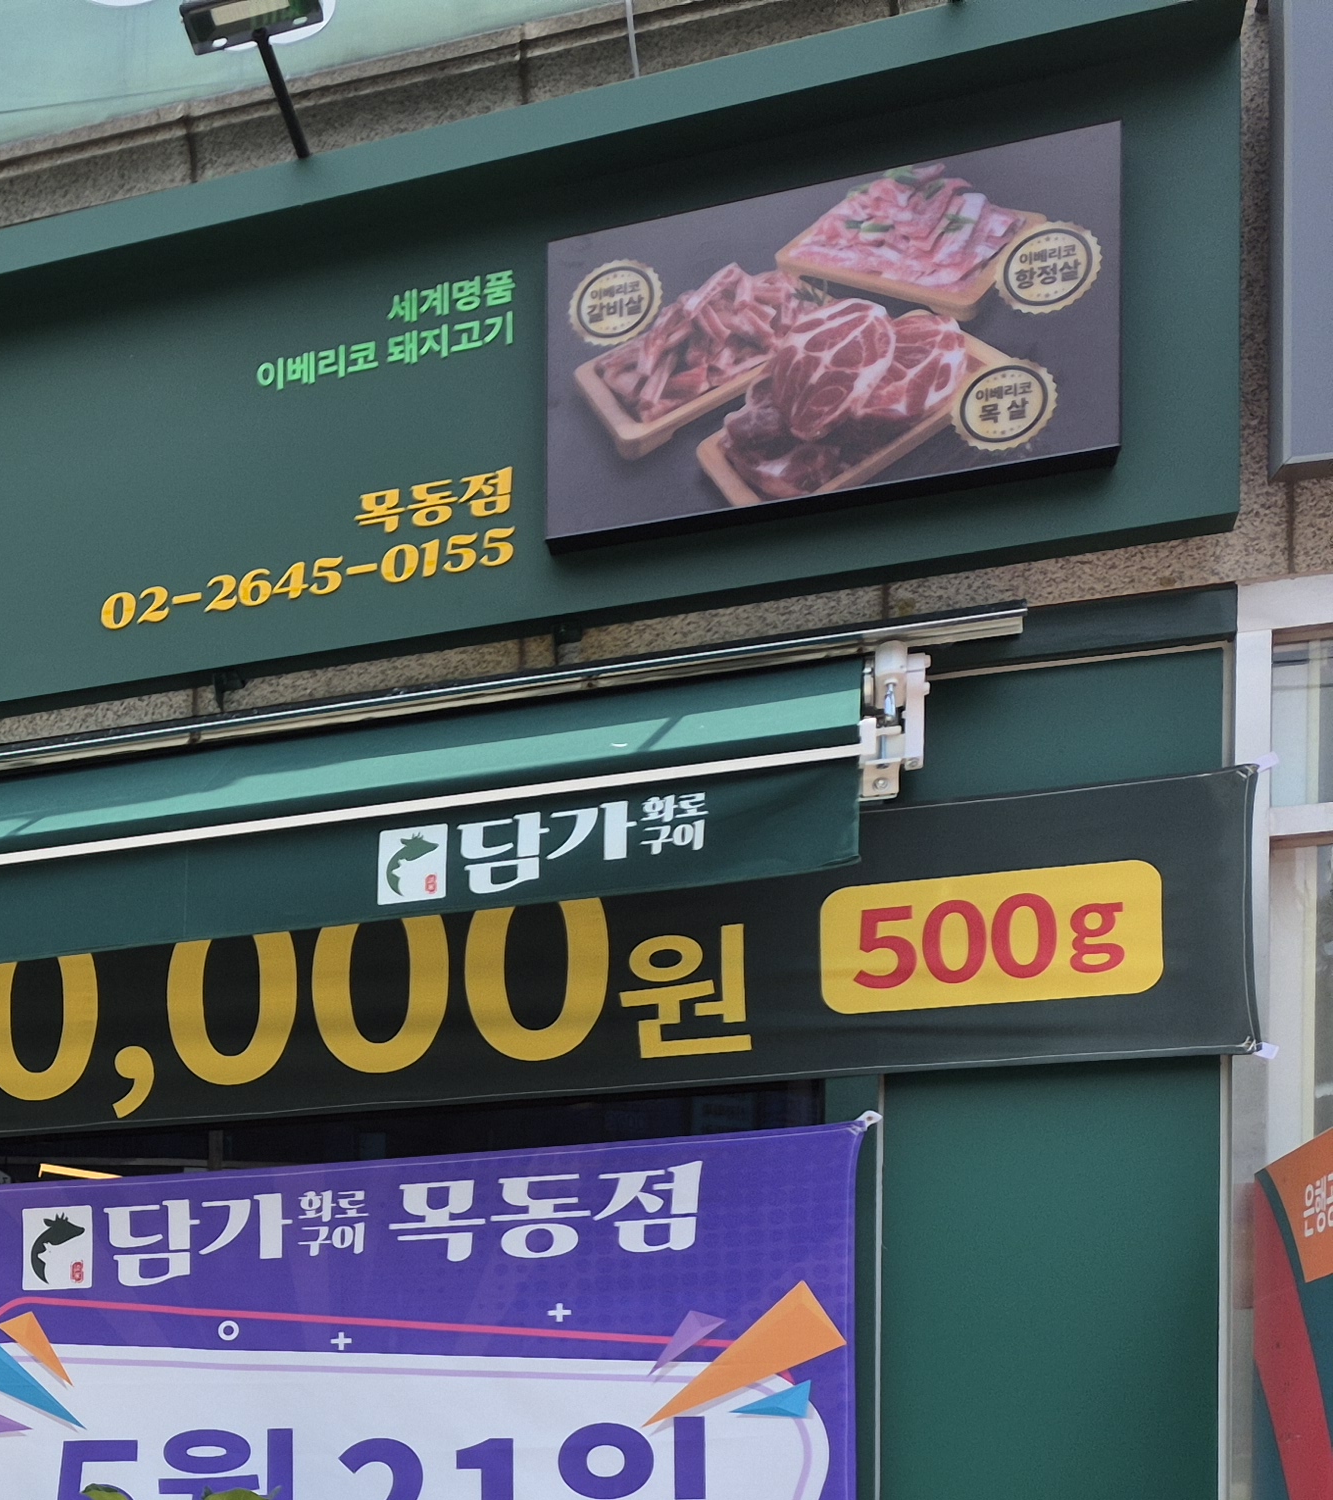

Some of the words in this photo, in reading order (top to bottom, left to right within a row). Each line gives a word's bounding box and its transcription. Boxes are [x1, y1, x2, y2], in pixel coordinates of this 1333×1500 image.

[1019, 244, 1077, 265] 이베리코
[589, 281, 641, 301] 이베리코
[1014, 259, 1082, 288] 항정살
[388, 268, 515, 326] 세계명품
[586, 295, 644, 325] 갈비살
[255, 335, 380, 394] 이베리코
[386, 309, 515, 368] 돼지고기
[974, 382, 1033, 403] 이베리코
[354, 465, 514, 535] 목동점
[99, 526, 515, 633] 02-2645-0155
[639, 790, 709, 823] 화로
[458, 802, 637, 895] 담가
[639, 821, 706, 856] 구이
[852, 890, 1127, 991] 500g
[297, 1187, 370, 1223] 화로
[388, 1159, 705, 1263] 목동점
[104, 1191, 294, 1288] 담가
[297, 1221, 366, 1258] 구이
